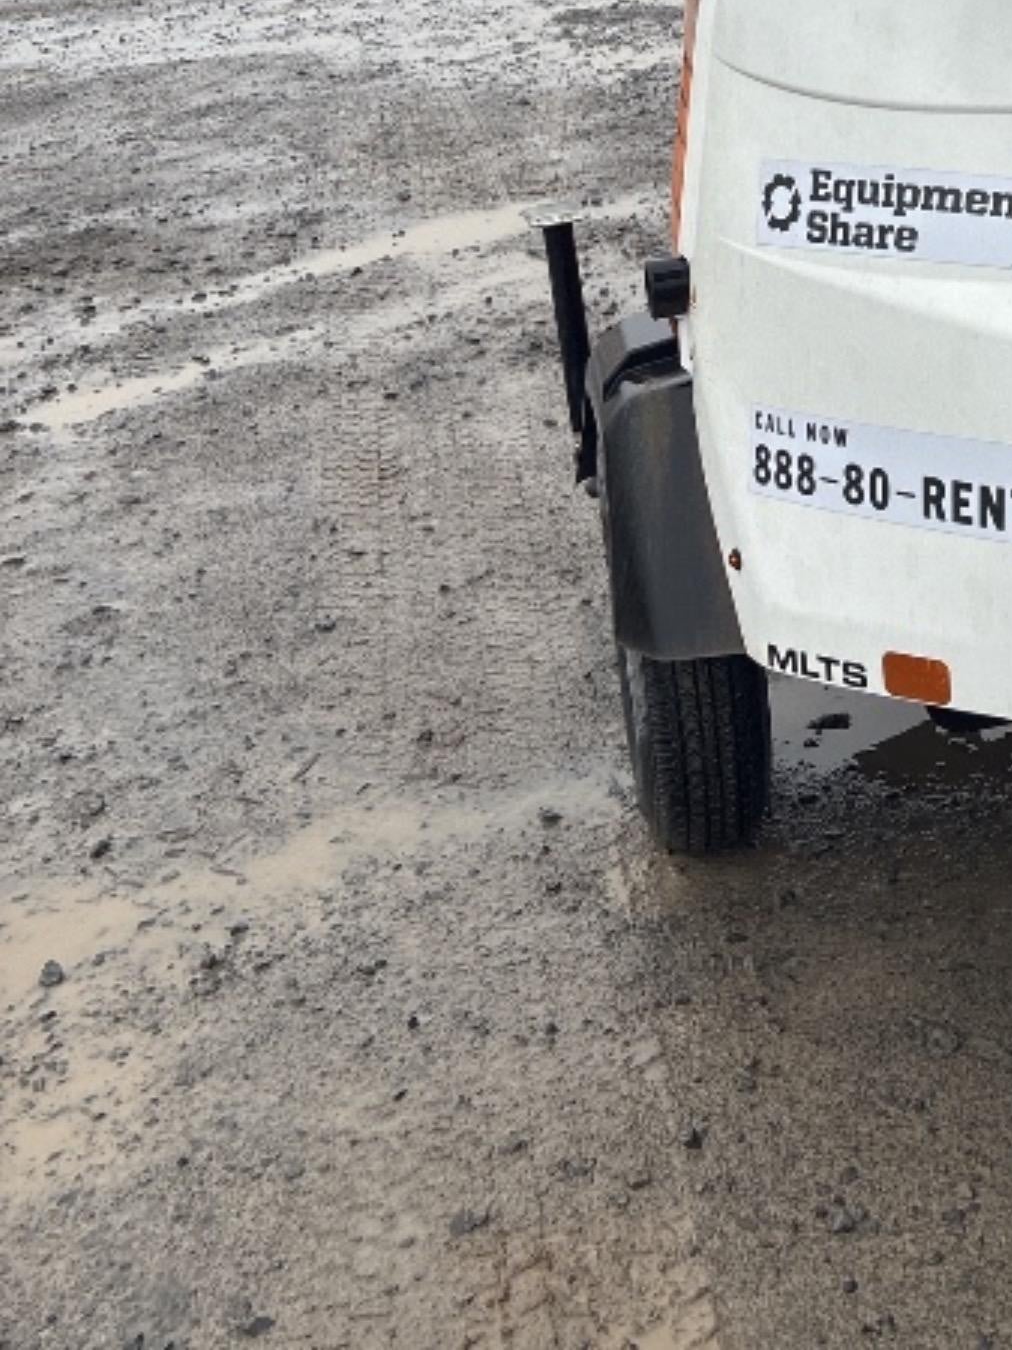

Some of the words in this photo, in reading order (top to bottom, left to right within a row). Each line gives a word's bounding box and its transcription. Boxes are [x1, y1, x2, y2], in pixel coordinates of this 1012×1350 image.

[806, 210, 918, 252] Share
[755, 410, 796, 439] CALL
[806, 422, 849, 448] NOW
[767, 643, 868, 688] MLTS
